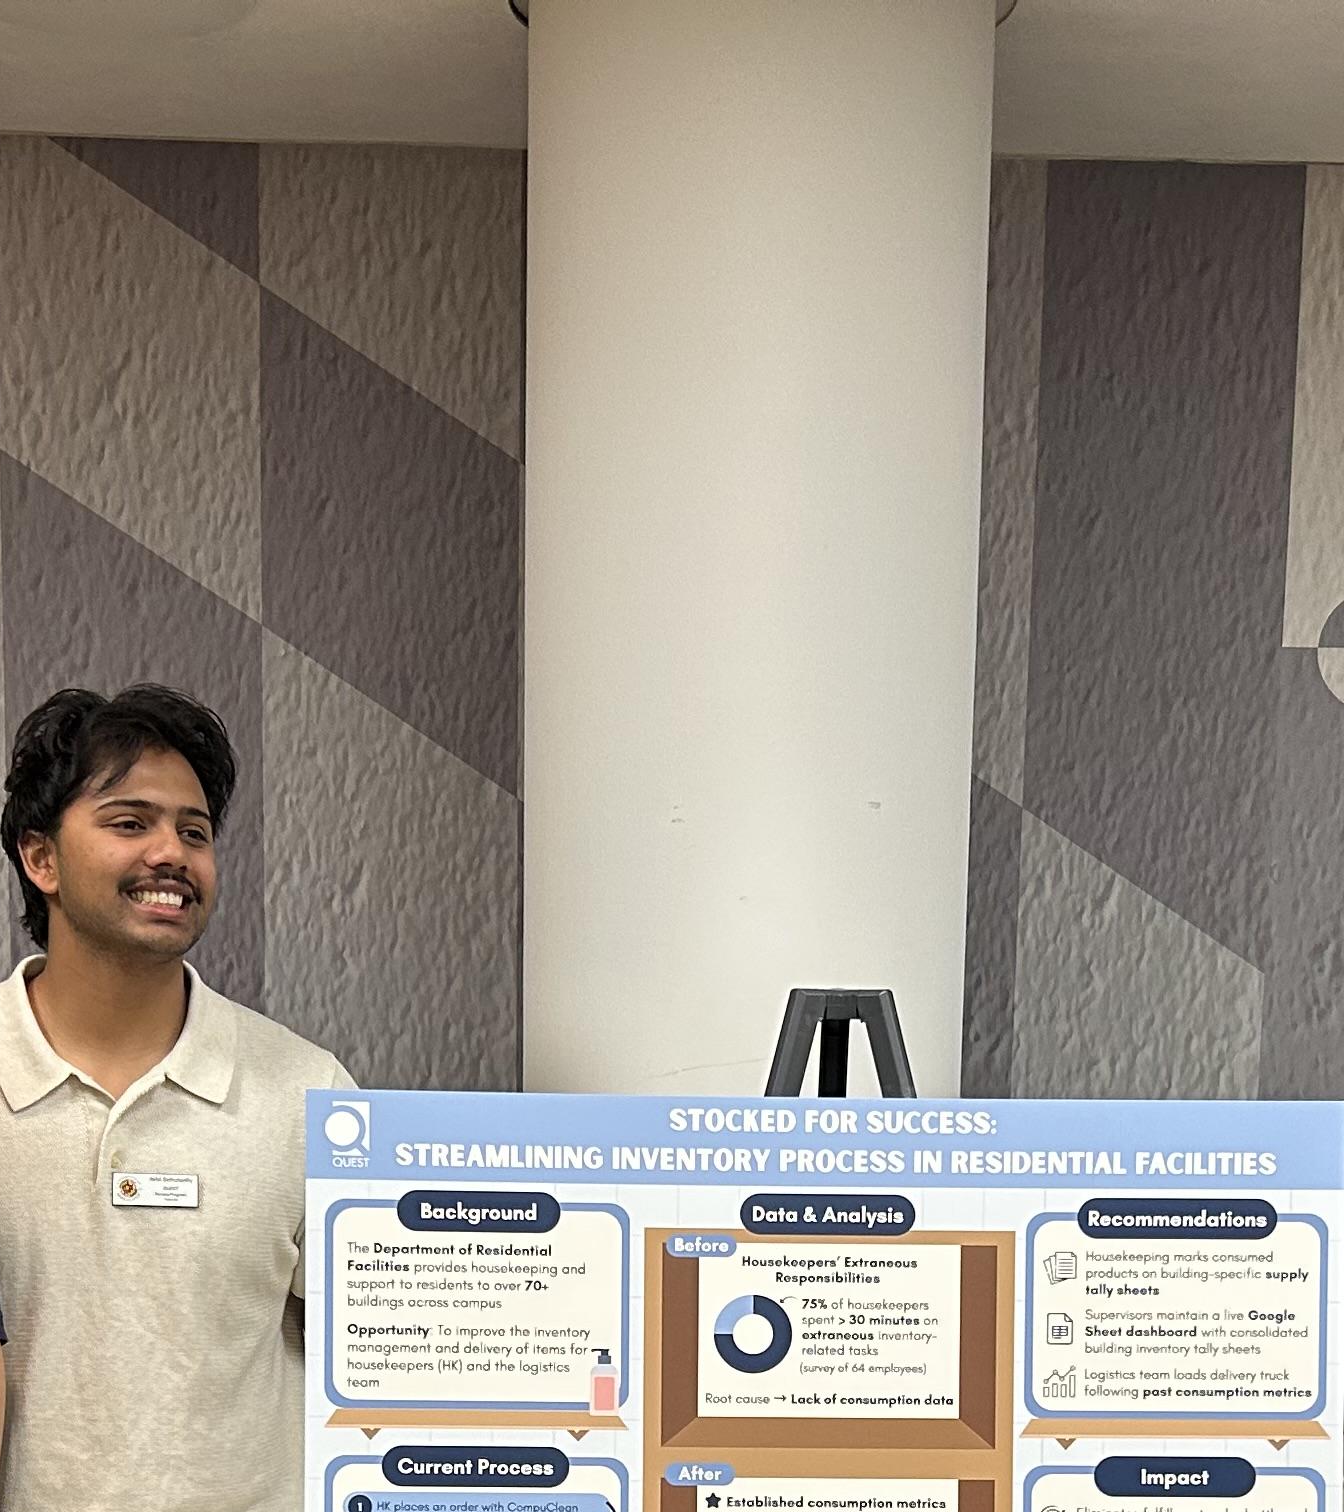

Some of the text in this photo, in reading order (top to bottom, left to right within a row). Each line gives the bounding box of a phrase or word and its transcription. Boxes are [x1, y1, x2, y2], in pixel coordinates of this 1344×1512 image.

[669, 1108, 996, 1134] STOCKED FOR SUCCESS:
[332, 1157, 370, 1167] QUEST
[395, 1143, 1276, 1175] STREAMLINING INVENTORY PROCESS IN RESIDENTIAL FACILITIES
[420, 1201, 536, 1225] Background
[752, 1205, 904, 1227] Data & Analysis
[1088, 1210, 1267, 1228] Recommendations
[347, 1242, 551, 1257] The Department of Residential
[671, 1236, 732, 1252] Before
[844, 1256, 917, 1268] Extraneous
[1086, 1250, 1273, 1264] Housekeeping marks consumed
[347, 1259, 585, 1277] Facilities provides housekeeping and
[346, 1279, 394, 1292] support
[399, 1280, 412, 1289] to
[416, 1278, 473, 1290] residents
[477, 1280, 489, 1290] to
[524, 1280, 549, 1291] 70+
[776, 1270, 880, 1287] Responsibilities
[1085, 1283, 1159, 1298] tally sheets
[802, 1298, 928, 1313] 75% of housekeepers
[802, 1315, 834, 1327] spent
[849, 1314, 865, 1324] 30
[869, 1314, 919, 1325] minutes
[437, 1324, 451, 1335] To
[456, 1328, 505, 1339] improve
[509, 1325, 530, 1336] the
[534, 1327, 590, 1340] inventory
[802, 1330, 936, 1343] extraneous inventory-
[1084, 1325, 1308, 1337] Sheet dashboard with consolidated
[347, 1358, 570, 1375] housekeepers (HK) and the logistics
[799, 1362, 926, 1375] (survey of 64 employees)
[1084, 1368, 1289, 1383] Logistics team loads delivery truck
[791, 1392, 953, 1408] Lack of consumption data
[1084, 1385, 1315, 1400] following past consumption metrics
[397, 1458, 553, 1474] Current Process
[676, 1465, 722, 1480] After
[1141, 1468, 1209, 1489] Impact
[357, 1502, 362, 1511] 1
[376, 1501, 390, 1510] HK
[394, 1500, 429, 1512] places
[449, 1501, 478, 1511] order
[481, 1501, 504, 1511] with
[726, 1495, 946, 1511] Established consumption metrics
